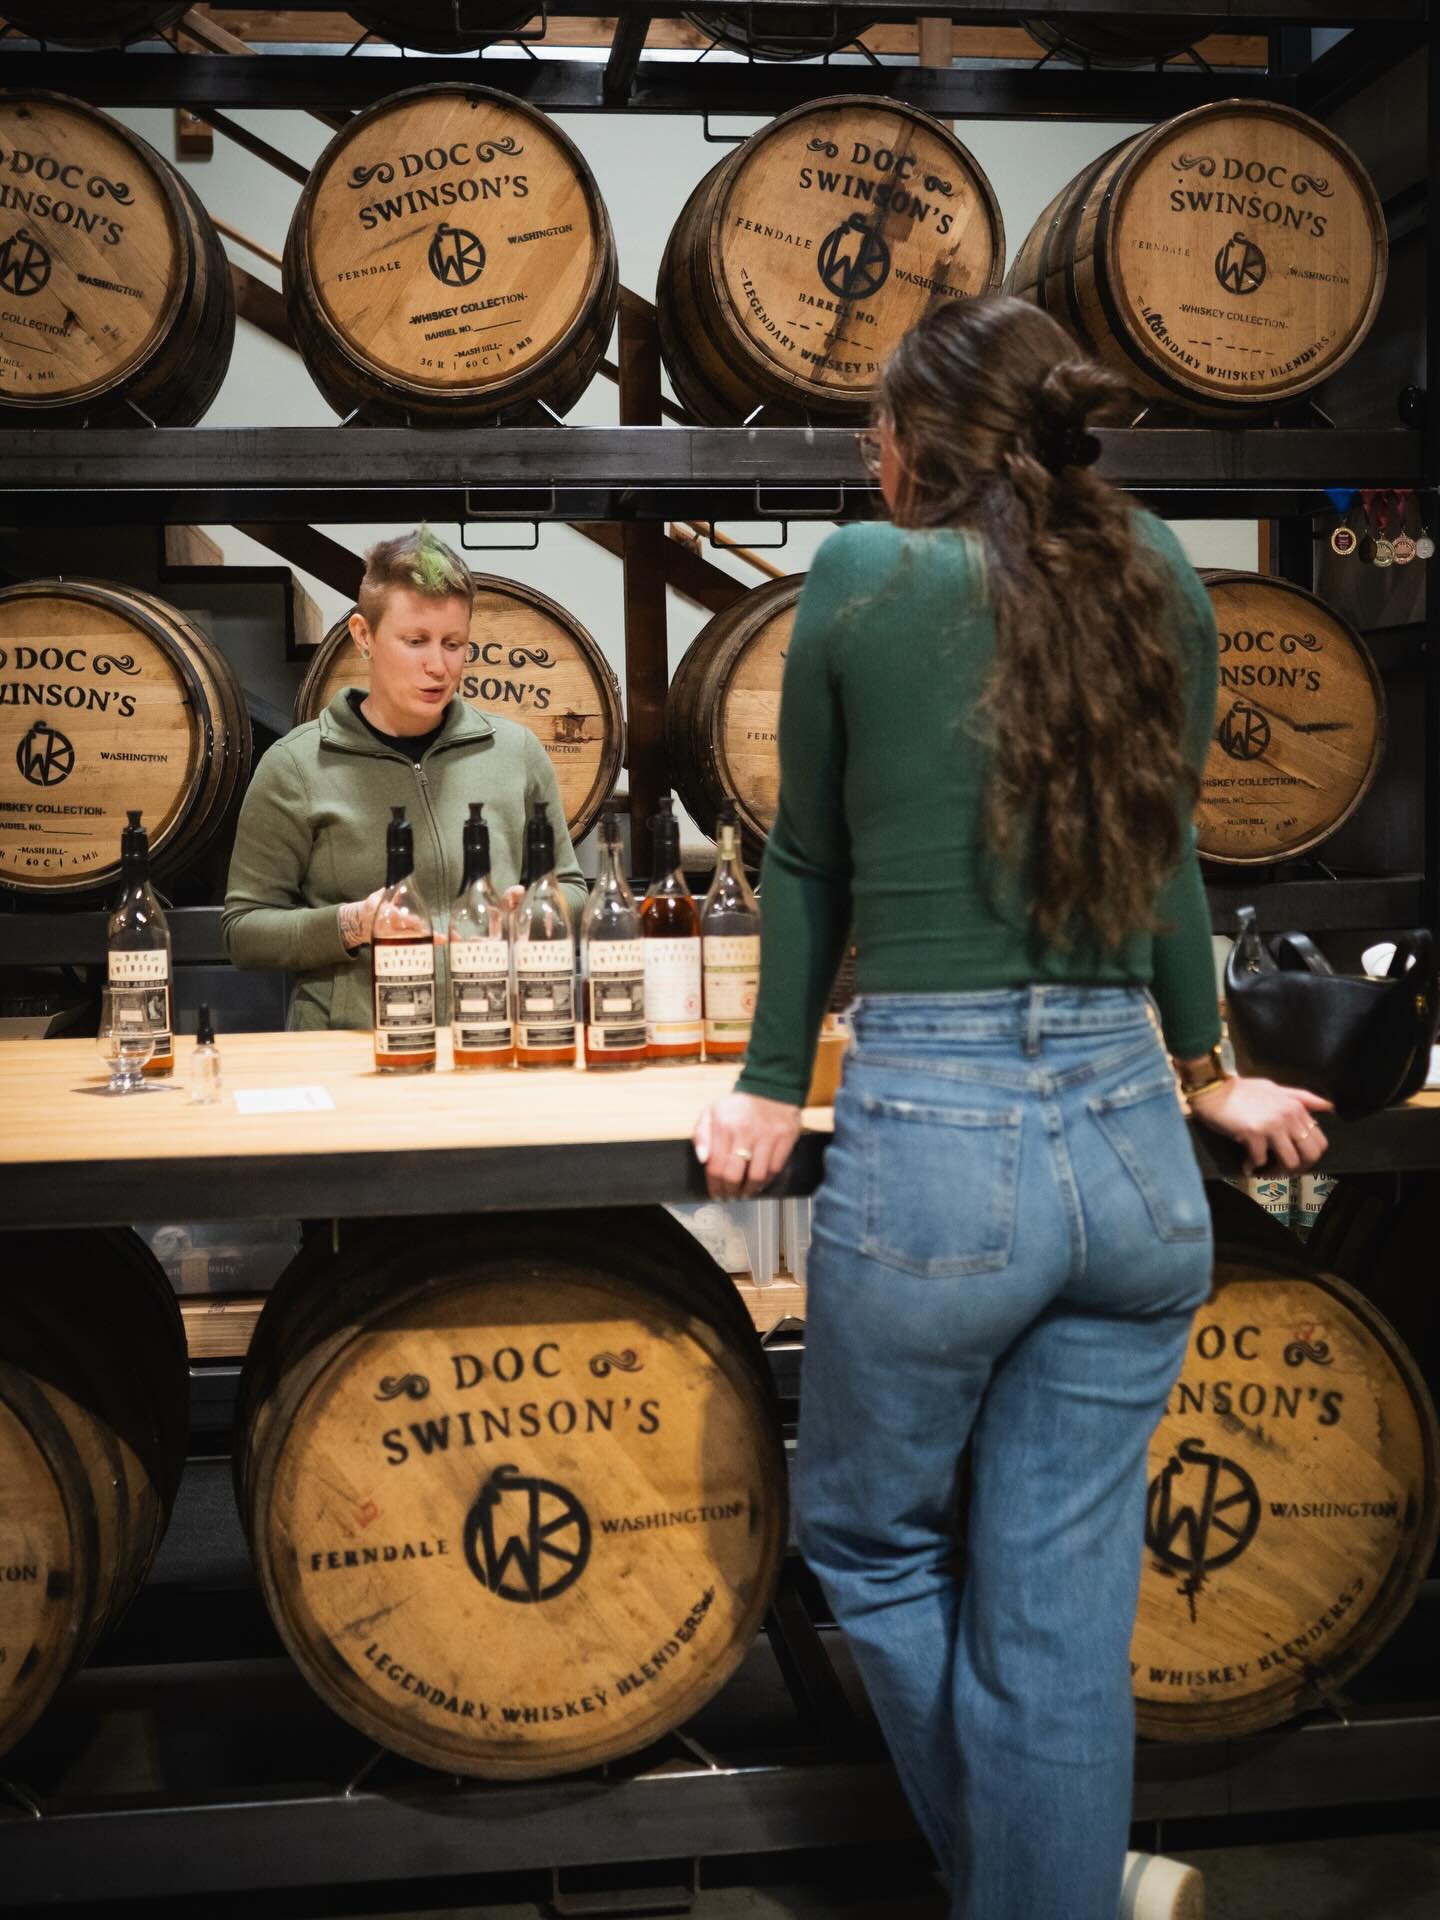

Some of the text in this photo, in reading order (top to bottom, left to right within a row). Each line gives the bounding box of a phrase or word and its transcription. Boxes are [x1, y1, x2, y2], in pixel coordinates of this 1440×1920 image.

[9, 150, 83, 189] DOC
[399, 143, 472, 178] DOC
[851, 142, 916, 180] DOC
[1222, 158, 1287, 188] DOC
[0, 184, 124, 246] INSON'S
[359, 175, 529, 230] SWINSON'S
[799, 168, 954, 235] SWINSON'S
[1170, 190, 1328, 238] SWINSON'S
[507, 224, 573, 245] WASHINGTON
[735, 217, 812, 250] FERNDALE
[77, 273, 143, 299] WASHINGTON
[337, 261, 402, 282] FERNDALE
[1289, 267, 1349, 285] WASHINGTON
[798, 293, 878, 327] BARREL NO.
[424, 327, 458, 342] BARREL
[742, 281, 862, 374] LEGENDARY WHISKEY
[1141, 307, 1330, 381] LEGENDARY WHISKEY BLENDERS
[14, 647, 87, 672] DOC
[464, 641, 503, 665] OC
[458, 676, 551, 709] SON'S
[1219, 665, 1321, 692] NSON'S
[100, 751, 168, 763] WASHINGTON
[1196, 1324, 1262, 1361] OC
[452, 1342, 562, 1391] DOC
[1176, 1381, 1344, 1426] NSON'S
[382, 1397, 661, 1466] SWINSON'S
[601, 1502, 742, 1535] WASHINGTON
[1270, 1502, 1399, 1521] WASHINGTON
[311, 1538, 450, 1572] FERNDALE
[1149, 1593, 1354, 1686] WHISKEY BLENDERS
[364, 1598, 709, 1723] LEGENDARY WHISKEY BLENDERS
